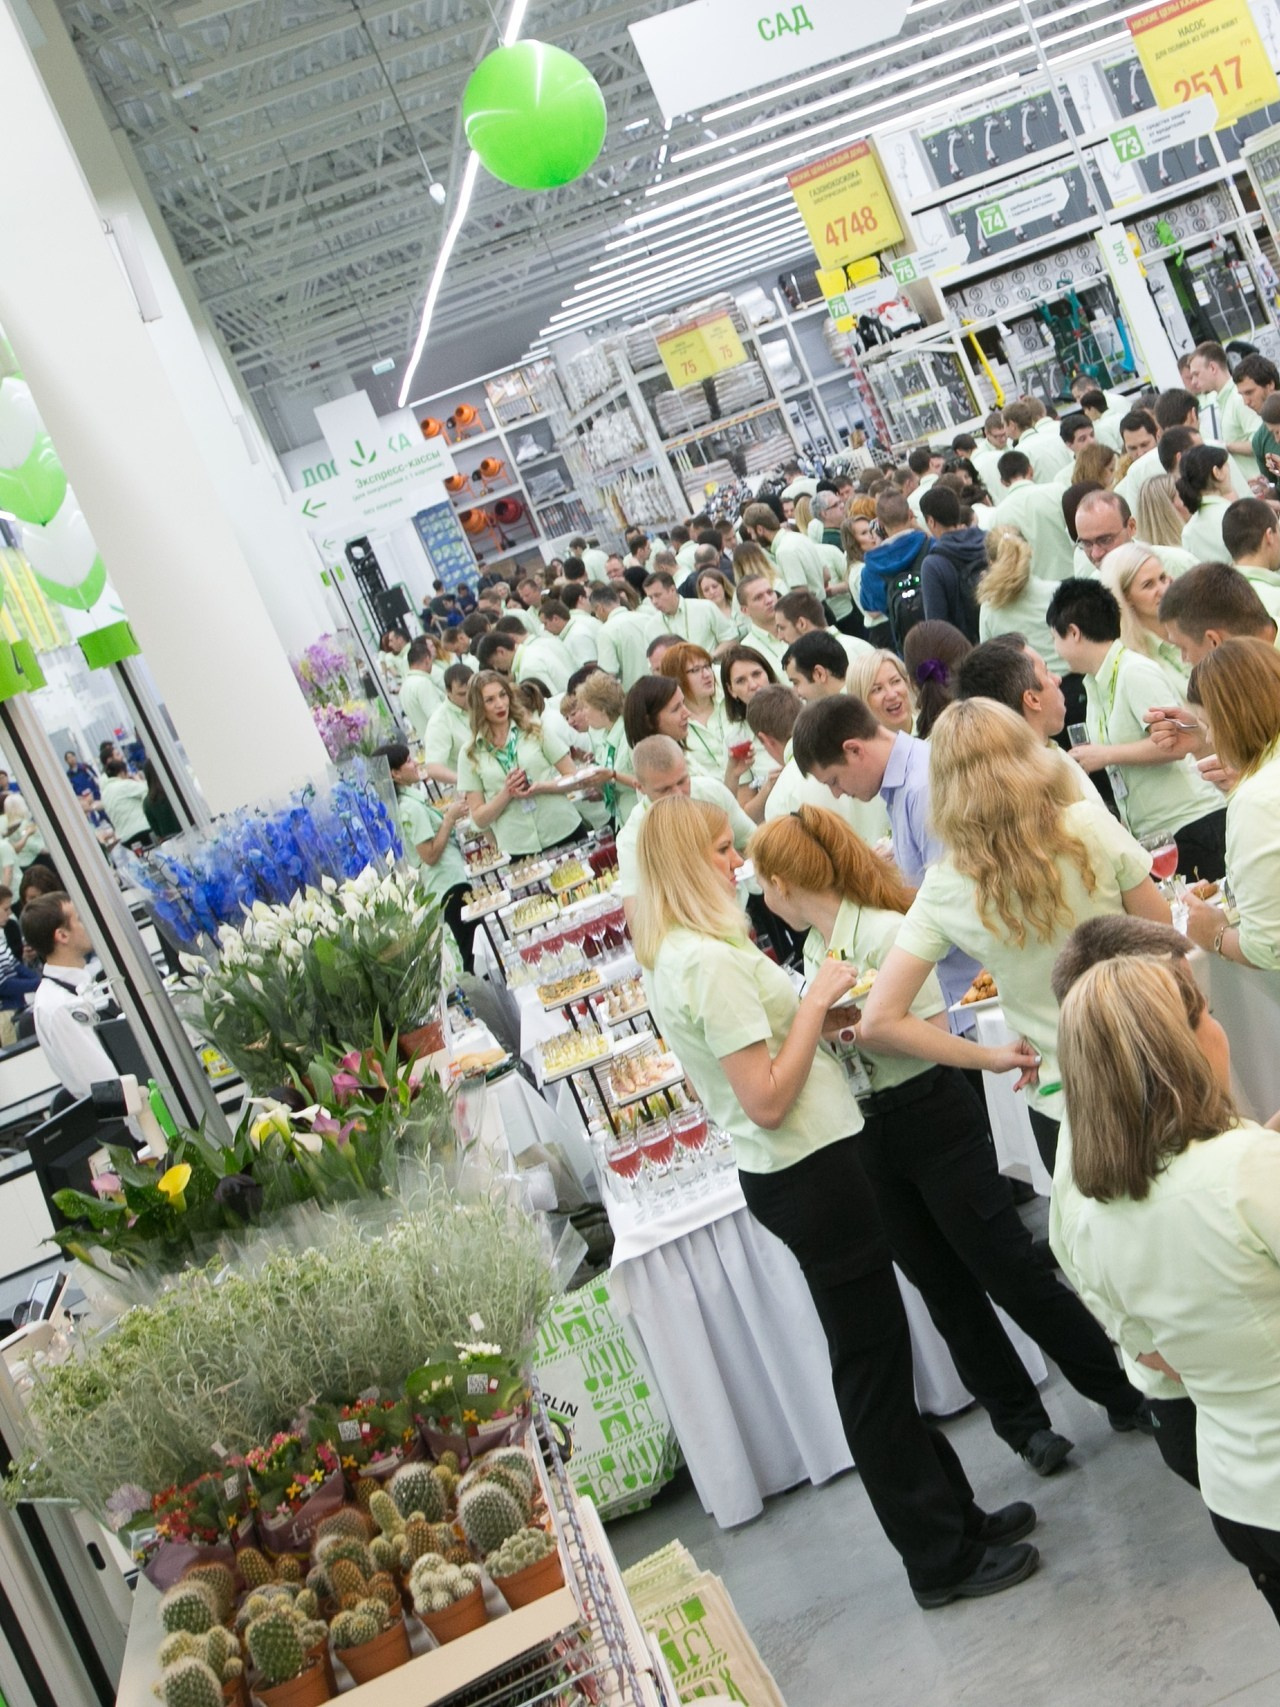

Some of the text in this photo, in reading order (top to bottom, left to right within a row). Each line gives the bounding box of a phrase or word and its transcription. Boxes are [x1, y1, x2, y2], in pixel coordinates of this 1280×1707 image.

[757, 4, 814, 41] САД
[1177, 18, 1206, 36] НАСОС
[1174, 55, 1243, 103] 2517
[1116, 136, 1141, 159] 73
[809, 170, 860, 198] ГАЗОНОКОСИЛКА
[826, 206, 877, 246] 4748
[983, 212, 1004, 232] 74
[1113, 240, 1128, 264] САД
[896, 266, 914, 284] 75
[832, 303, 847, 318] 76
[719, 344, 733, 360] 75
[681, 359, 697, 376] 75
[355, 450, 441, 488] Экспресс-кассы
